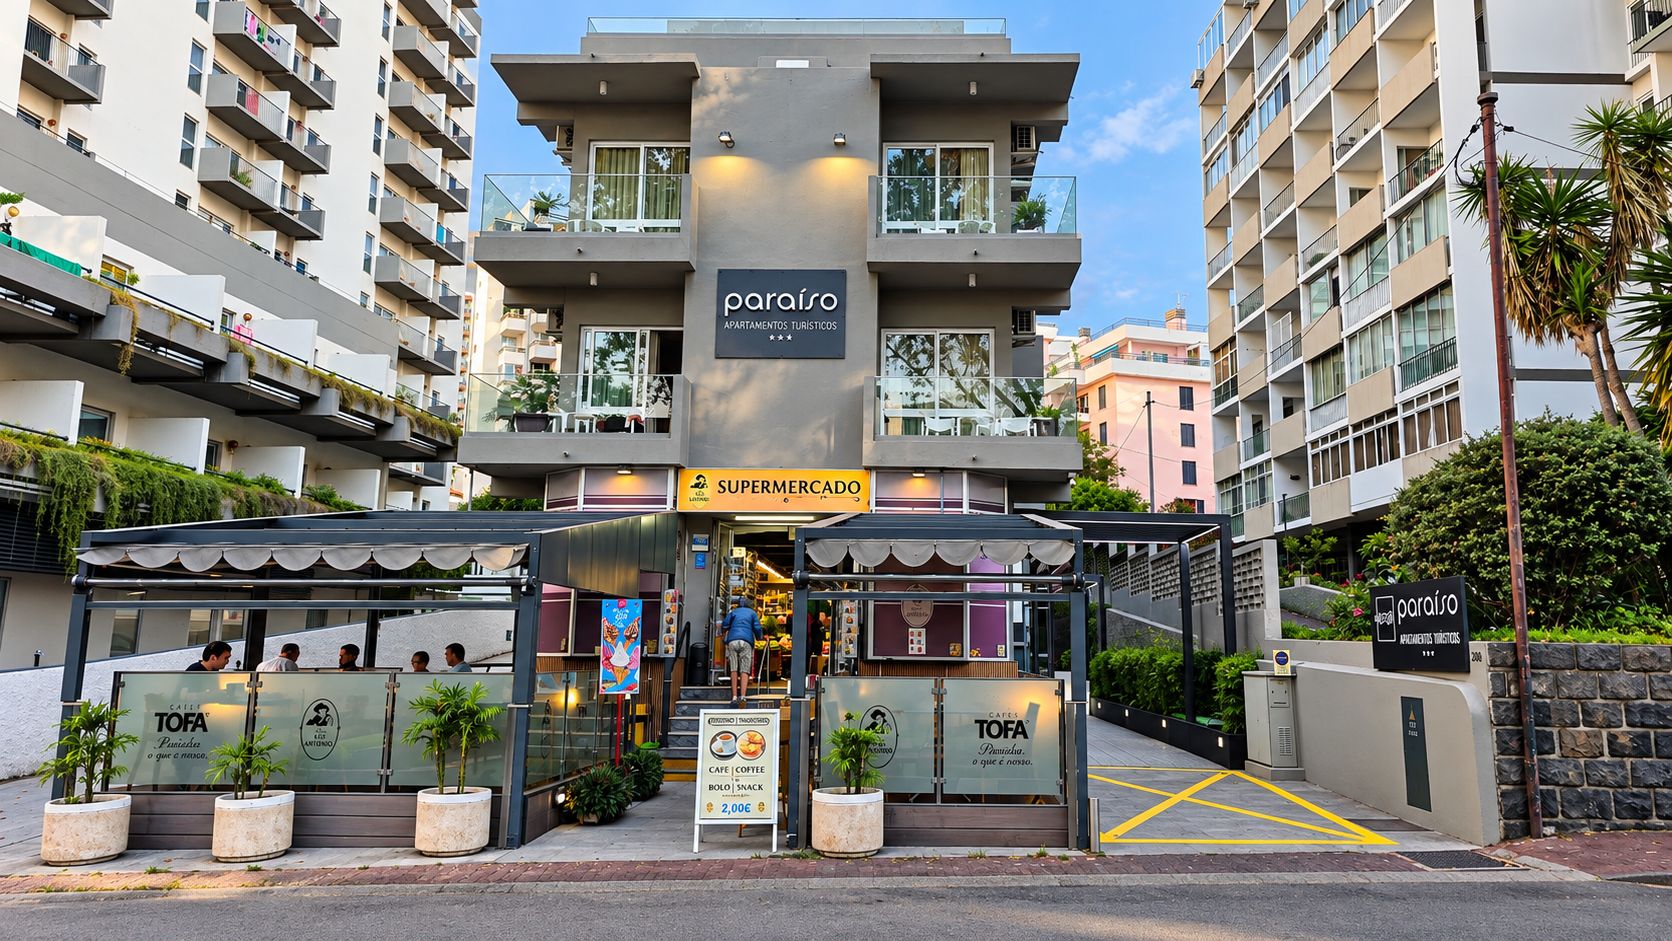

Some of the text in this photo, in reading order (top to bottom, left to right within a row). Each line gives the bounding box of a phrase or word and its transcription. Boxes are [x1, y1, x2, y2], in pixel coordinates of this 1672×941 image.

[724, 288, 838, 317] paraíso
[724, 319, 837, 330] APARTAMENTOS TURÍSTICOS
[717, 479, 861, 494] SUPERMERCADO
[1397, 589, 1459, 625] paraíso
[154, 712, 208, 733] TOFA
[974, 719, 1029, 740] TOFA
[708, 784, 763, 792] BOLO SNACK
[721, 803, 751, 815] 2,00€
